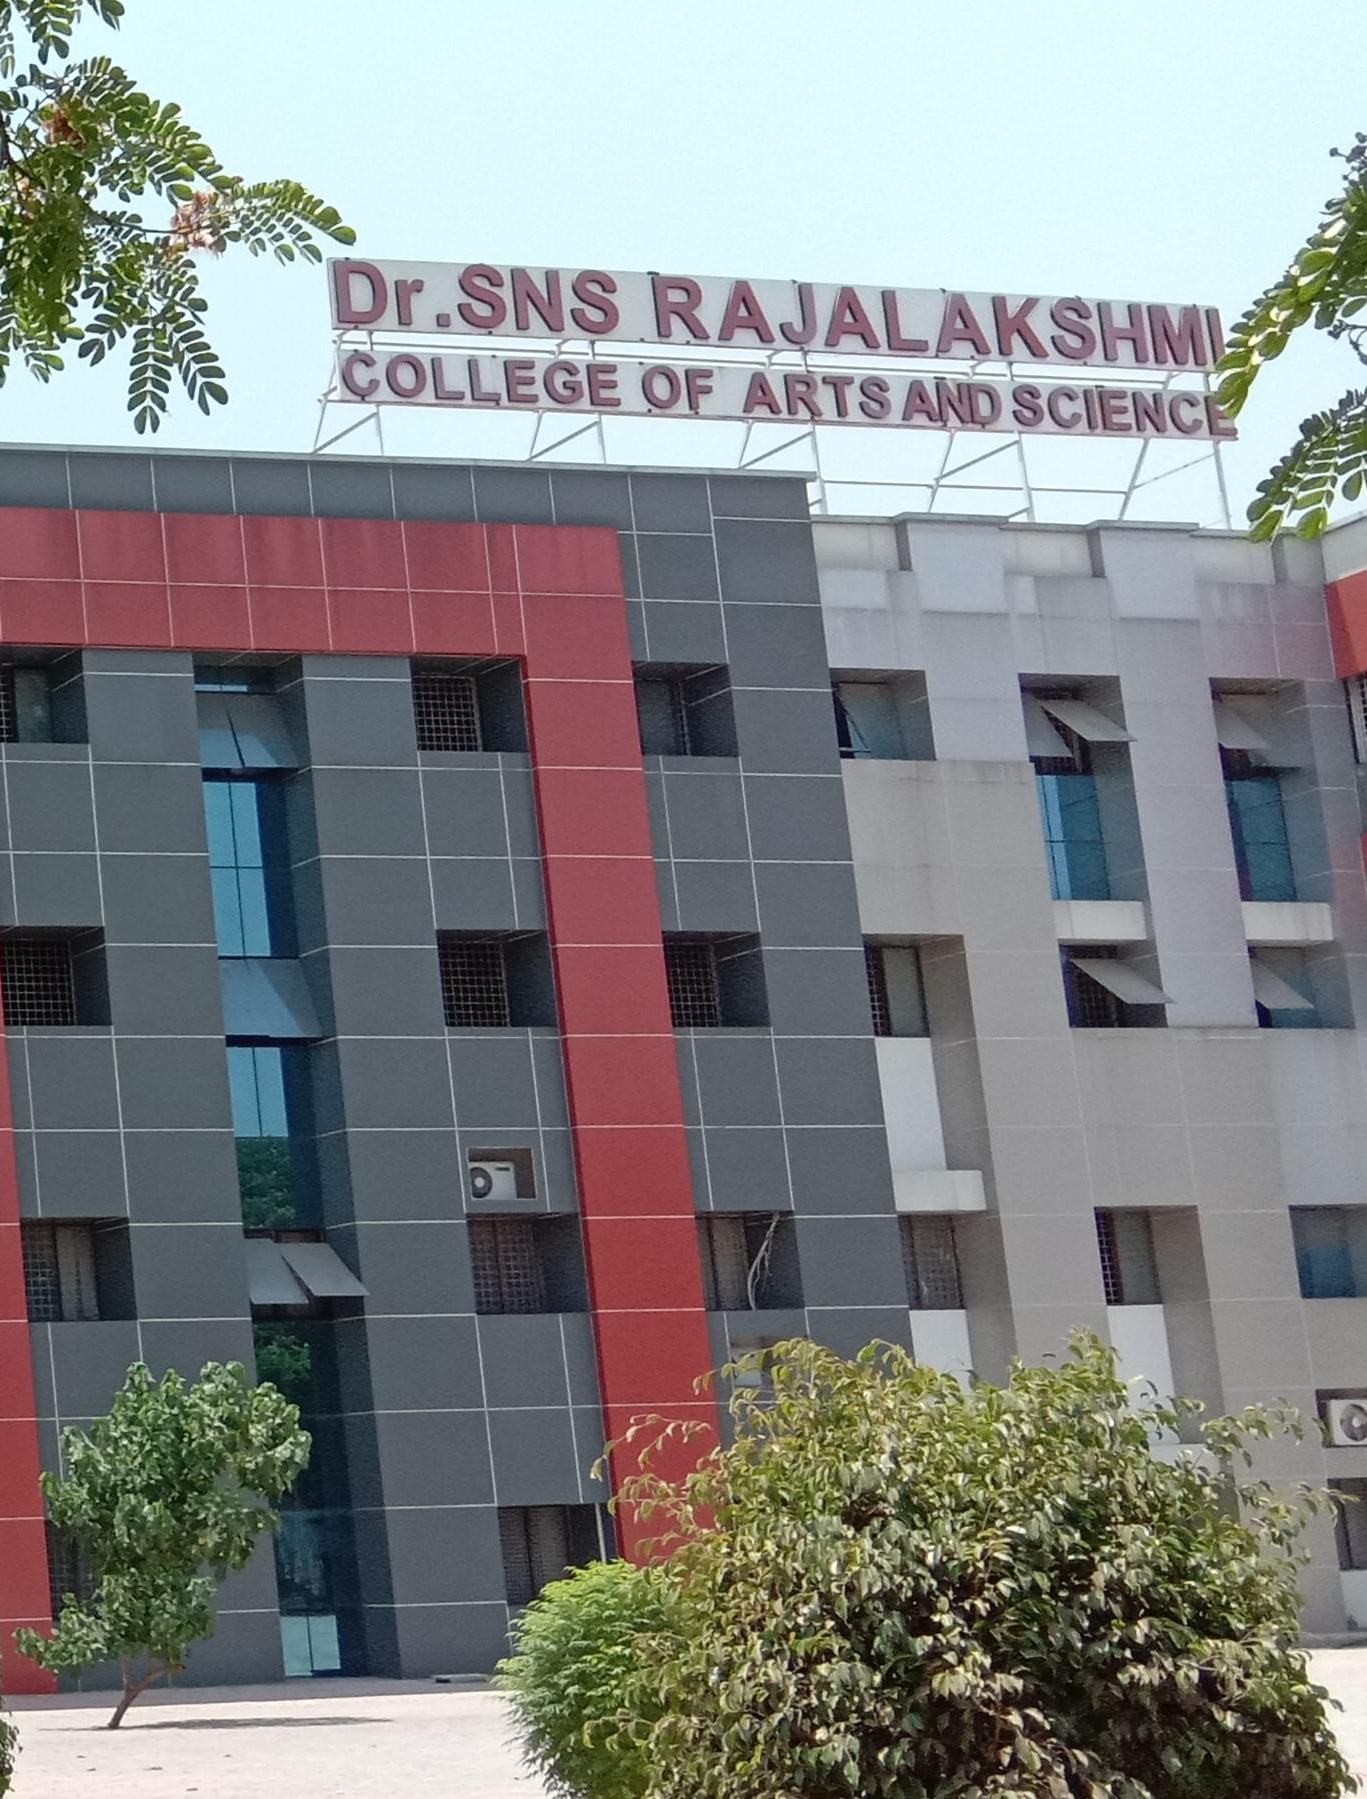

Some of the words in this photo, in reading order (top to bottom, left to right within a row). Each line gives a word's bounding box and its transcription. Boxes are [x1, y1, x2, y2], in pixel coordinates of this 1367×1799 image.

[333, 260, 620, 335] Dr.SNS
[651, 275, 1226, 366] RAJALAKSHMI
[341, 352, 621, 407] COLLEGE
[641, 365, 714, 412] OF
[743, 371, 892, 420] ARTS
[902, 378, 1002, 427] AND
[1012, 383, 1239, 438] SCIENCE
